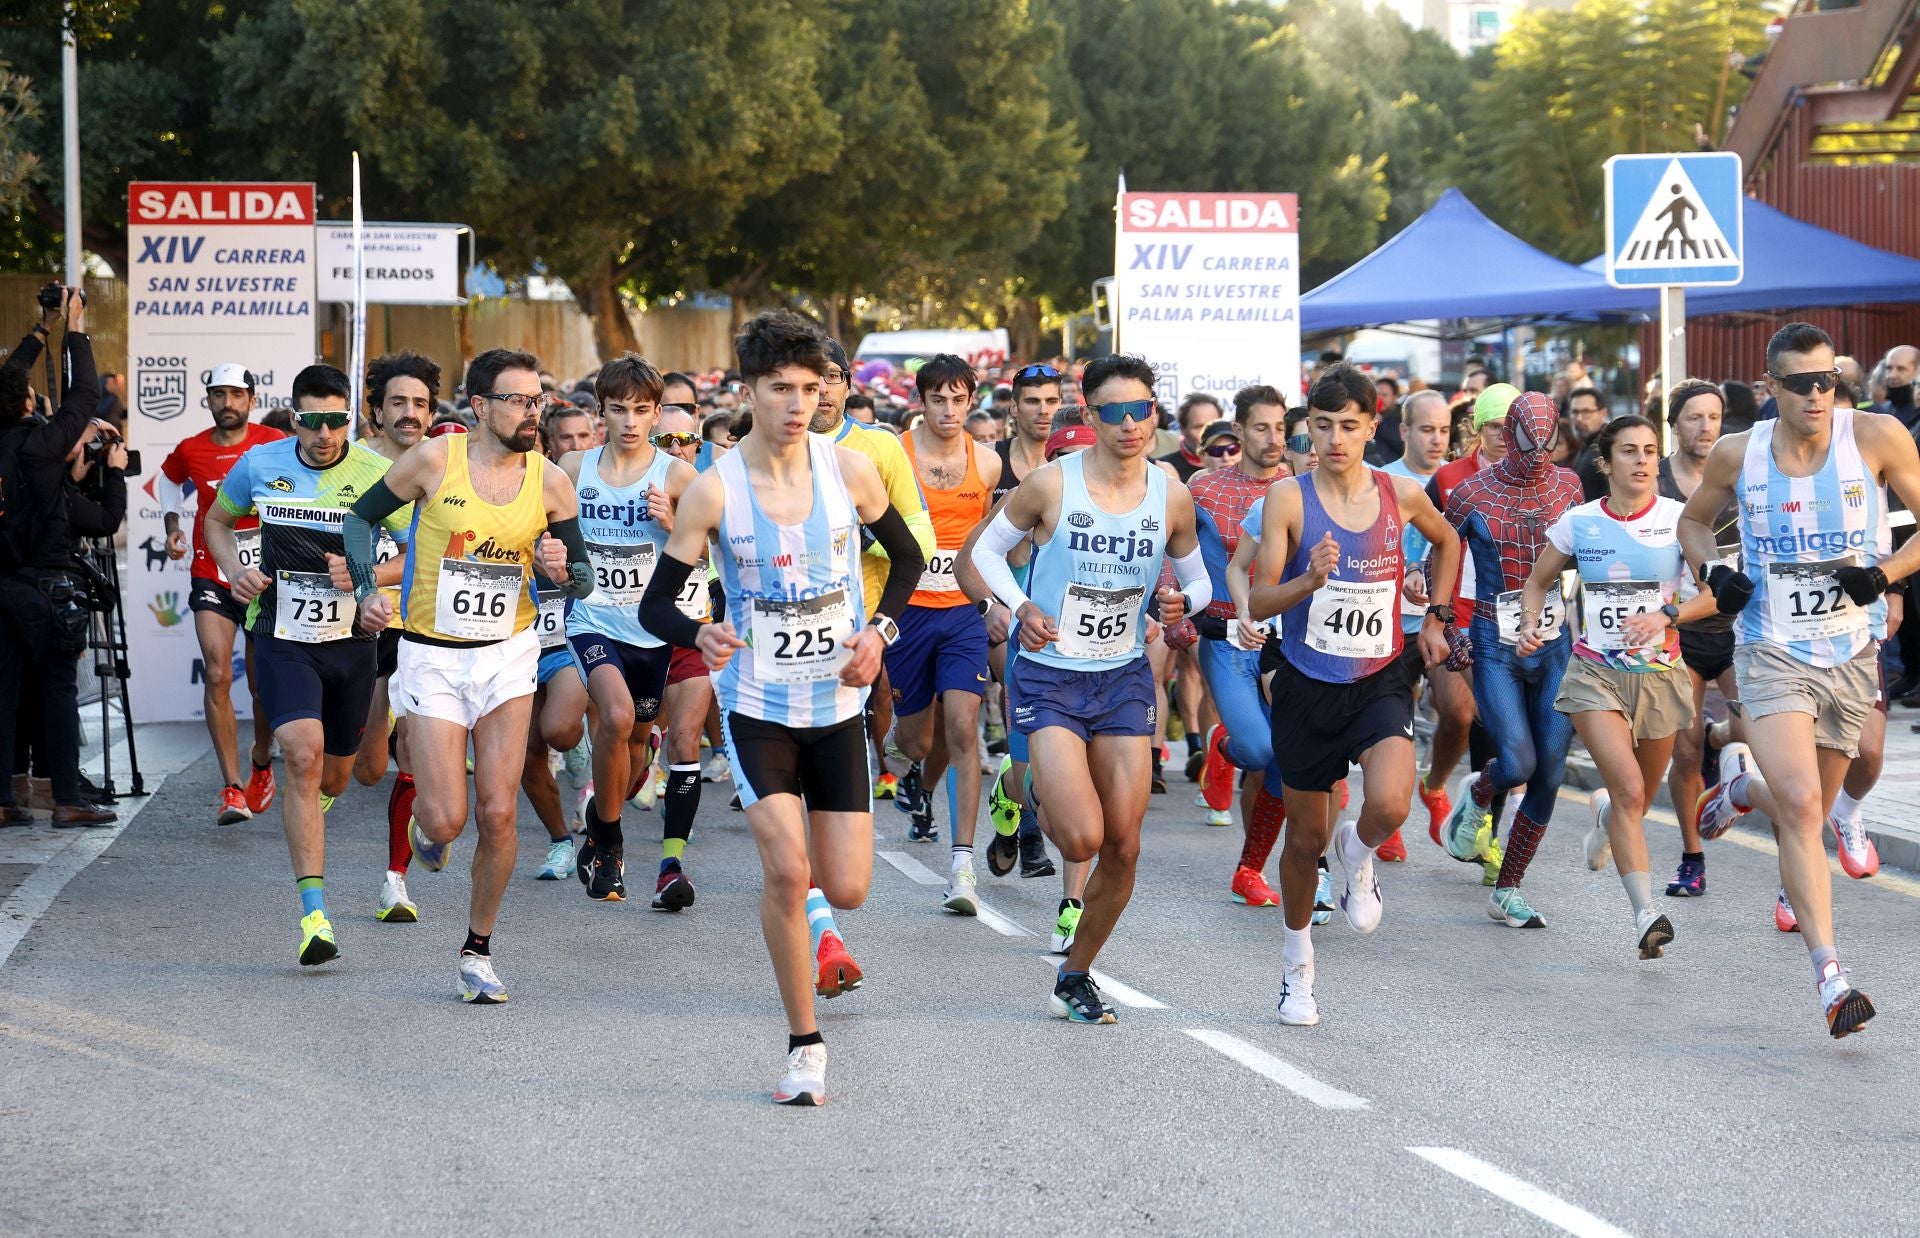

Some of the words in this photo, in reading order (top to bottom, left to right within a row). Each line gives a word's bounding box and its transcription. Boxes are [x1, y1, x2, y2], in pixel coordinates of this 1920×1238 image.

[138, 190, 305, 220] SALIDA
[1129, 199, 1289, 228] SALIDA
[137, 236, 206, 264] XIV
[214, 249, 306, 264] CARRERA
[1129, 243, 1194, 270] XIV
[1202, 257, 1289, 271] CARRERA
[332, 267, 434, 280] FEERADOS
[148, 276, 189, 292] SAN
[195, 277, 297, 292] SILVESTRE
[1141, 284, 1179, 298] SAN
[1185, 284, 1281, 299] SILVESTRE
[135, 301, 204, 316] PALMA
[211, 301, 309, 316] PALMILLA
[1128, 307, 1193, 321] PALMA
[1199, 308, 1294, 322] PALMILLA
[1747, 484, 1768, 493] vive
[581, 500, 654, 527] nerja
[1068, 513, 1094, 527] TROPS
[591, 527, 644, 538] ATLETISMO
[730, 535, 755, 545] vive
[1068, 530, 1154, 562] nerja
[1578, 547, 1616, 556] Málaga
[1078, 561, 1141, 576] ATLETISMO
[1348, 555, 1398, 573] lapalma
[596, 567, 644, 590] 301
[1326, 584, 1374, 595] COMPETICIONES
[292, 598, 341, 622] 731
[453, 590, 506, 617] 616
[1789, 585, 1847, 617] 122
[1077, 613, 1128, 639] 565
[1324, 607, 1384, 637] 406
[773, 626, 835, 659] 225
